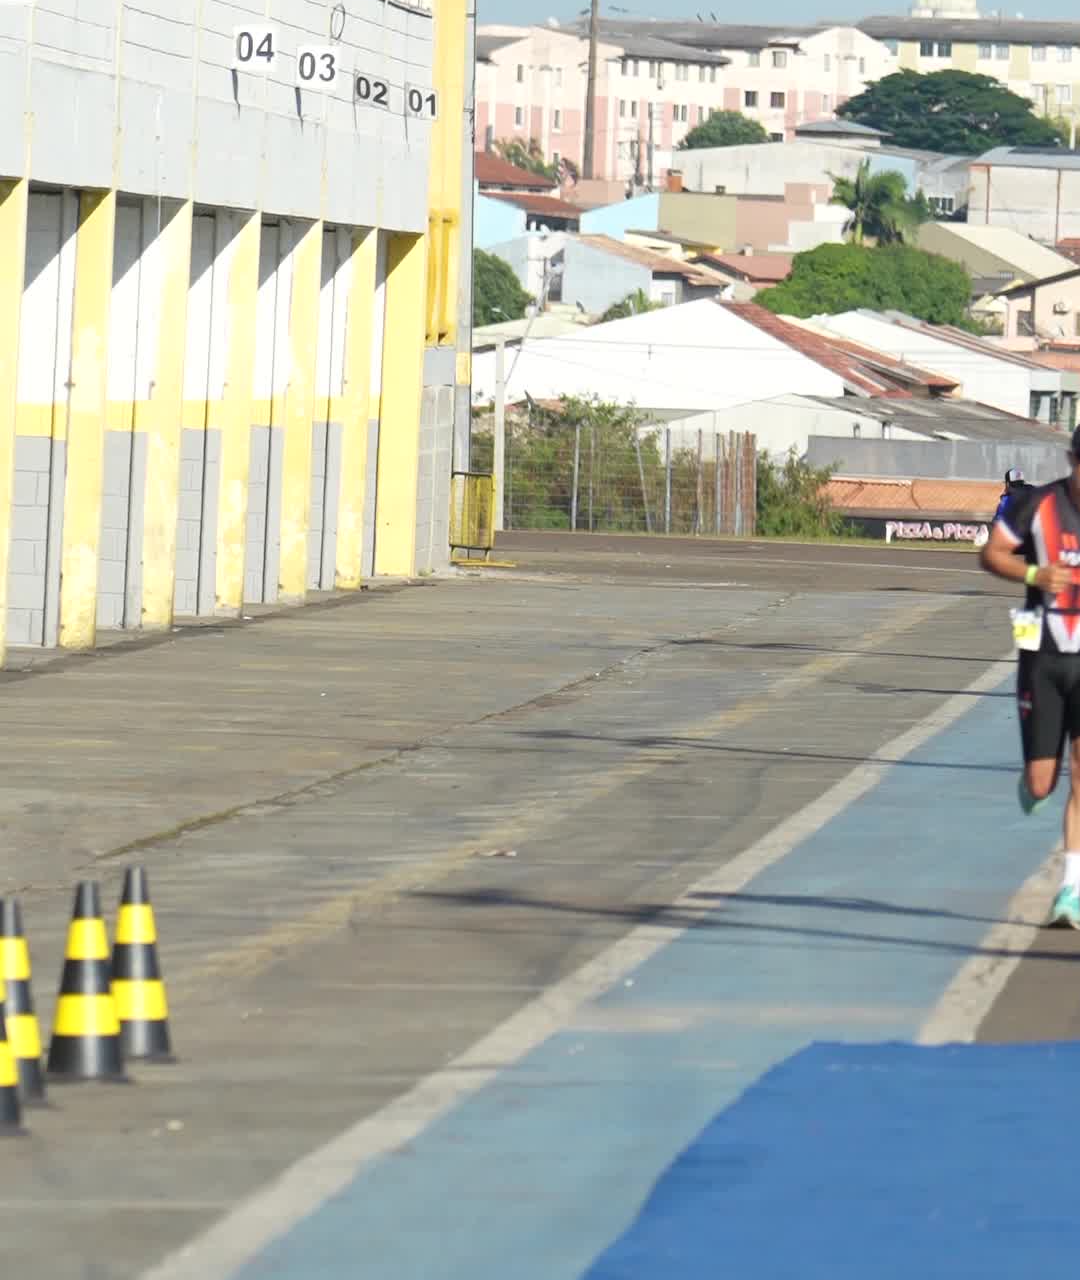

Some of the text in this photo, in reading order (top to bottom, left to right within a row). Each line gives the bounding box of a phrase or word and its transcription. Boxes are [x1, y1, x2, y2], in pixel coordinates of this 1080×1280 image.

[237, 31, 275, 63] 04
[299, 52, 336, 82] 03
[356, 76, 388, 106] 02
[408, 89, 437, 116] 01
